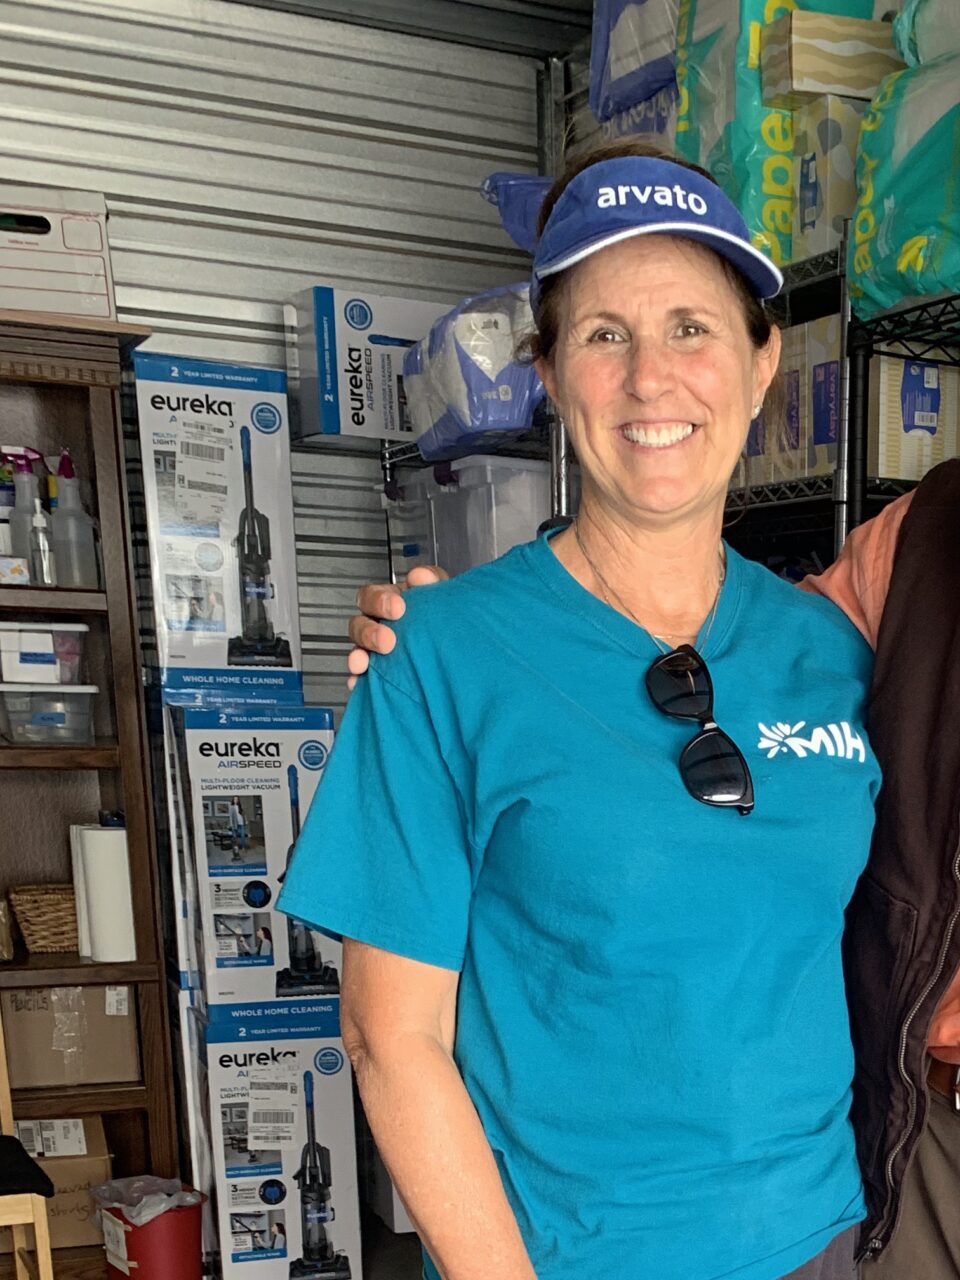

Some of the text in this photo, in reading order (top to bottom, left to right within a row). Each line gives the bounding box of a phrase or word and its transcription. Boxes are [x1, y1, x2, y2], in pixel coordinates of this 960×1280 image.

[597, 184, 708, 216] arvato
[171, 367, 258, 383] 2 YEAR LIMITED WARRANTY
[364, 347, 375, 412] AIRSPEED
[344, 347, 365, 426] eureka
[324, 393, 334, 402] 2
[150, 394, 233, 417] eureka
[387, 383, 395, 430] LIGHTWEIGHT
[183, 675, 284, 685] WHOLE HOME CLEANING
[219, 714, 227, 724] 2
[198, 737, 281, 758] eureka
[217, 760, 282, 769] AIRSPEED
[214, 884, 221, 893] 3
[231, 1005, 333, 1018] WHOLE HOME CLEANING
[238, 1027, 246, 1037] 2
[231, 1184, 238, 1193] 3
